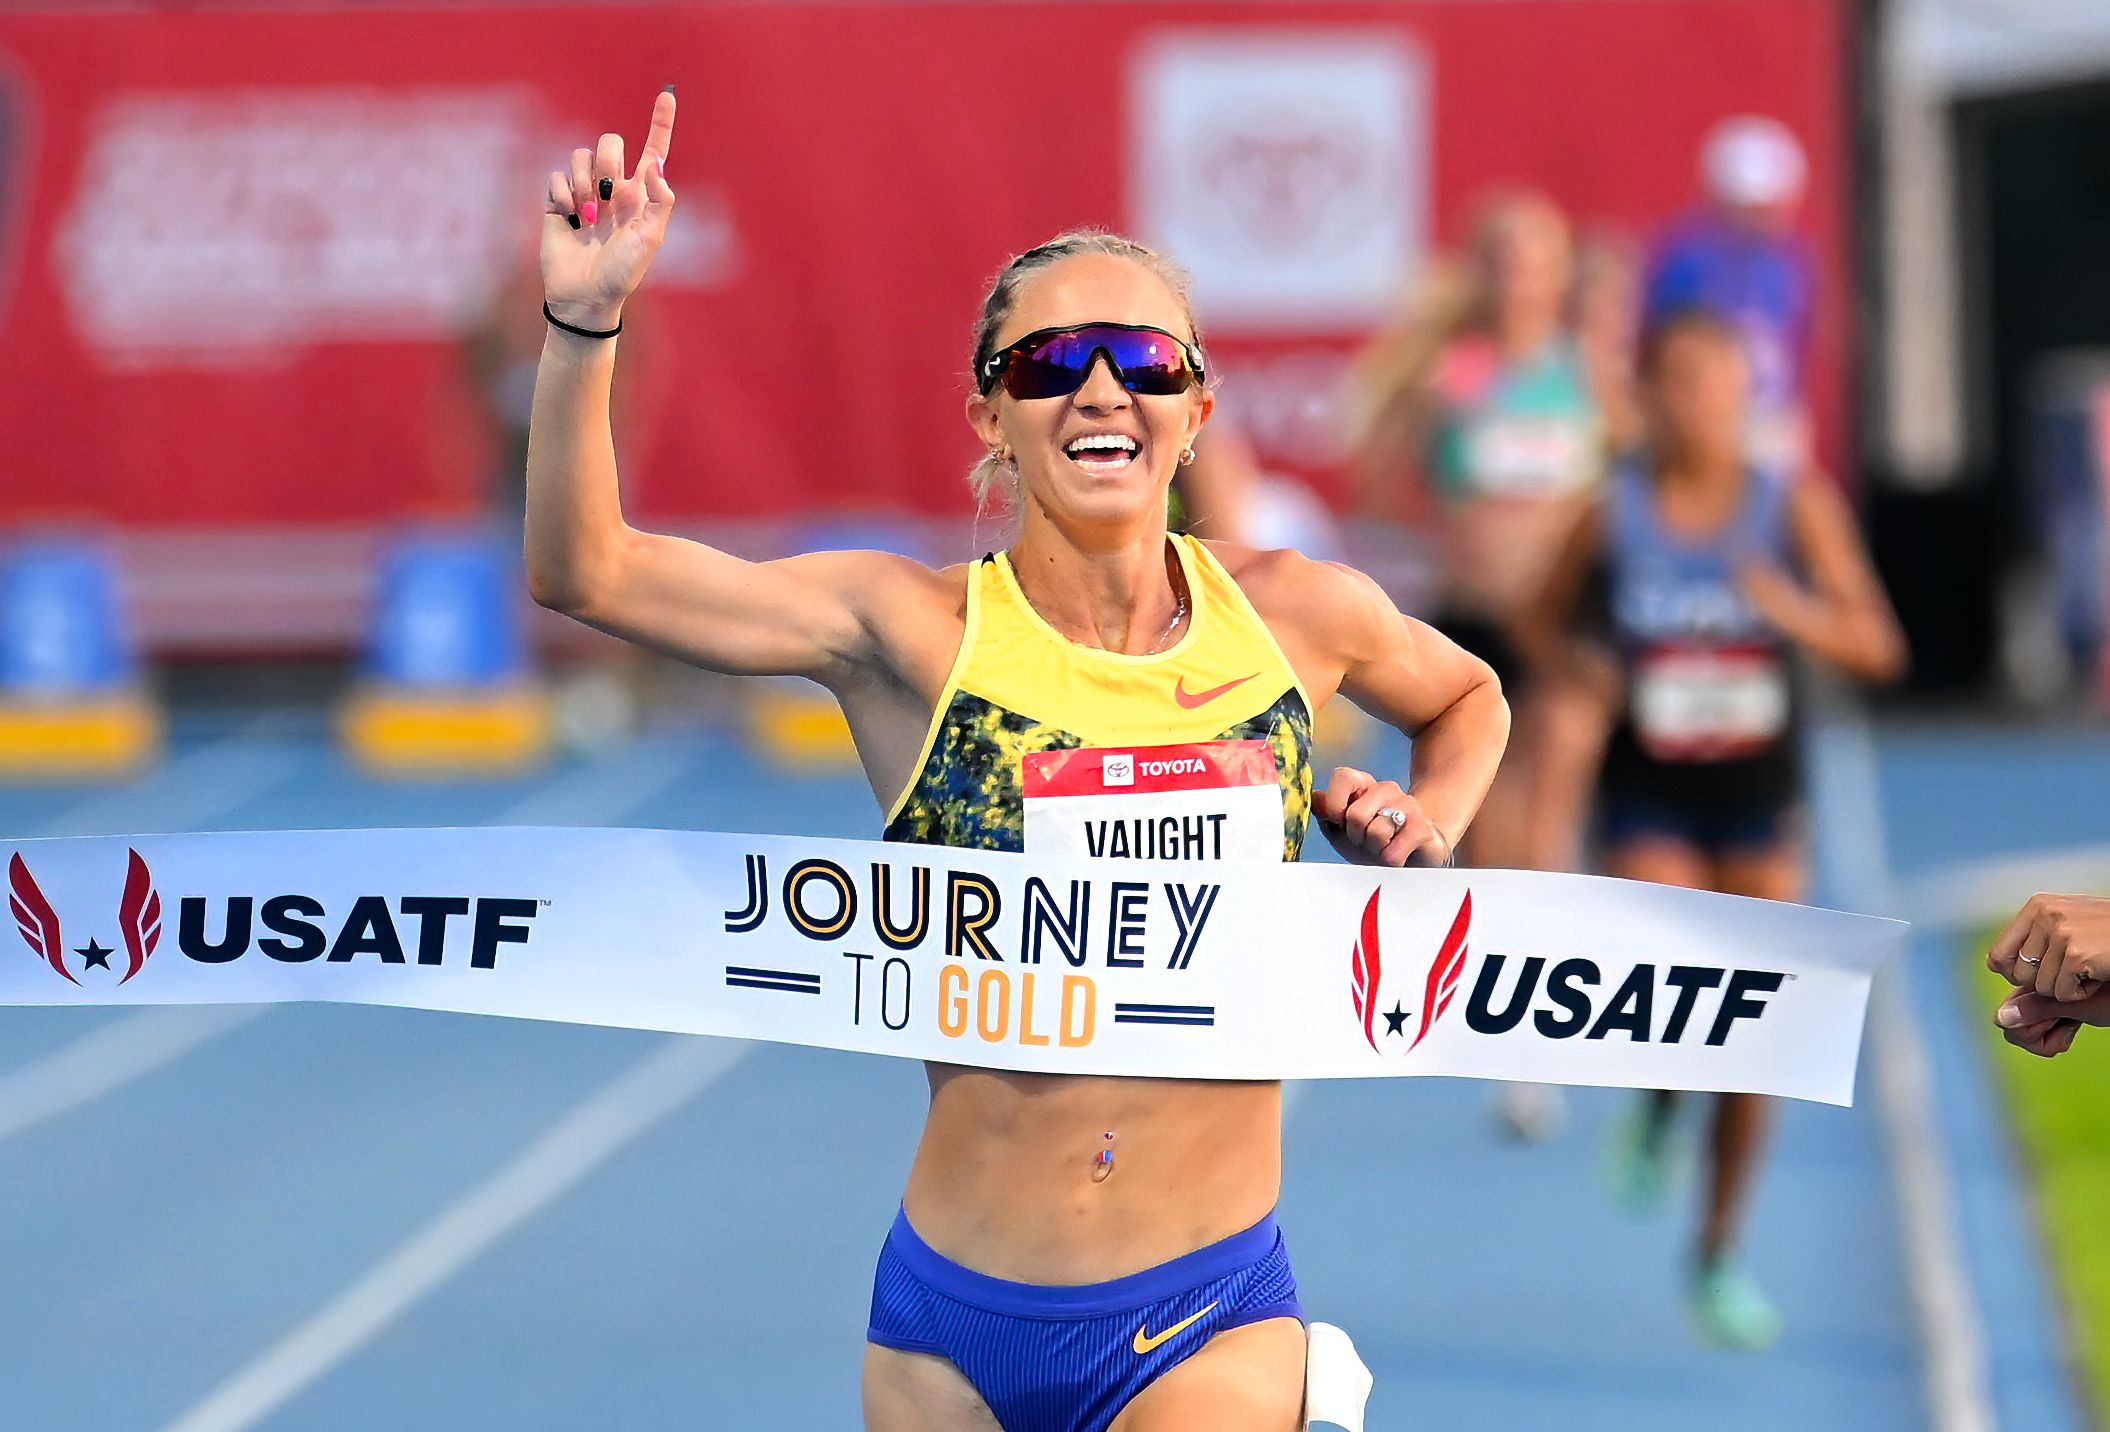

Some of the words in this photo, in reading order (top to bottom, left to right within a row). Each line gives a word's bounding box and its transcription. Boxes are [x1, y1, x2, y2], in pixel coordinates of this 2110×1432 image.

[1138, 758, 1206, 777] TOYOTA
[1084, 813, 1227, 861] VAUGHT
[178, 894, 538, 970] USATF
[724, 853, 1221, 970] JOURNEY
[842, 951, 912, 1031] TO
[938, 963, 1097, 1048] GOLD
[1465, 953, 1787, 1047] USATF
